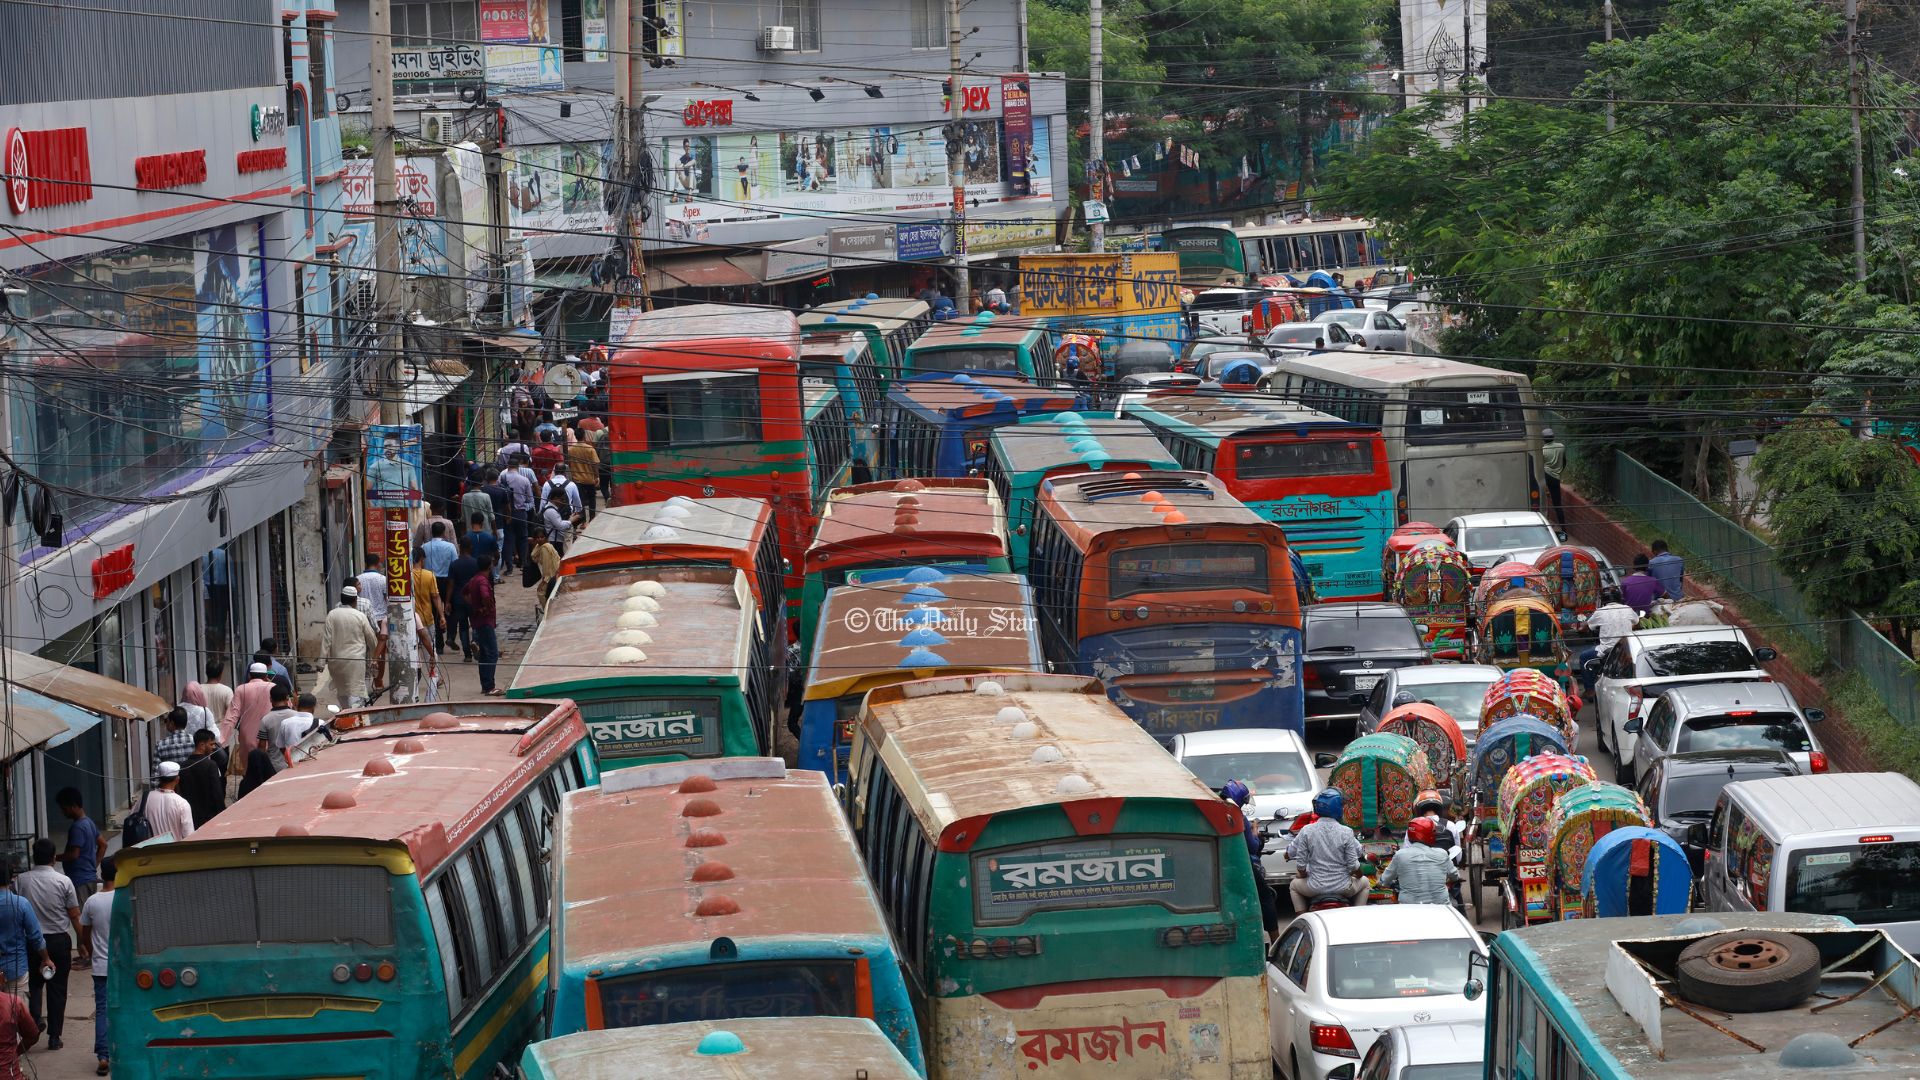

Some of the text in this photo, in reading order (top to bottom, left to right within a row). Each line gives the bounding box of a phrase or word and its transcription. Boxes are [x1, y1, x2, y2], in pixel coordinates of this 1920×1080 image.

[683, 205, 701, 219] Apex
[585, 714, 697, 741] মজান
[999, 853, 1166, 889] রমজান
[1016, 1016, 1167, 1071] রমজান
